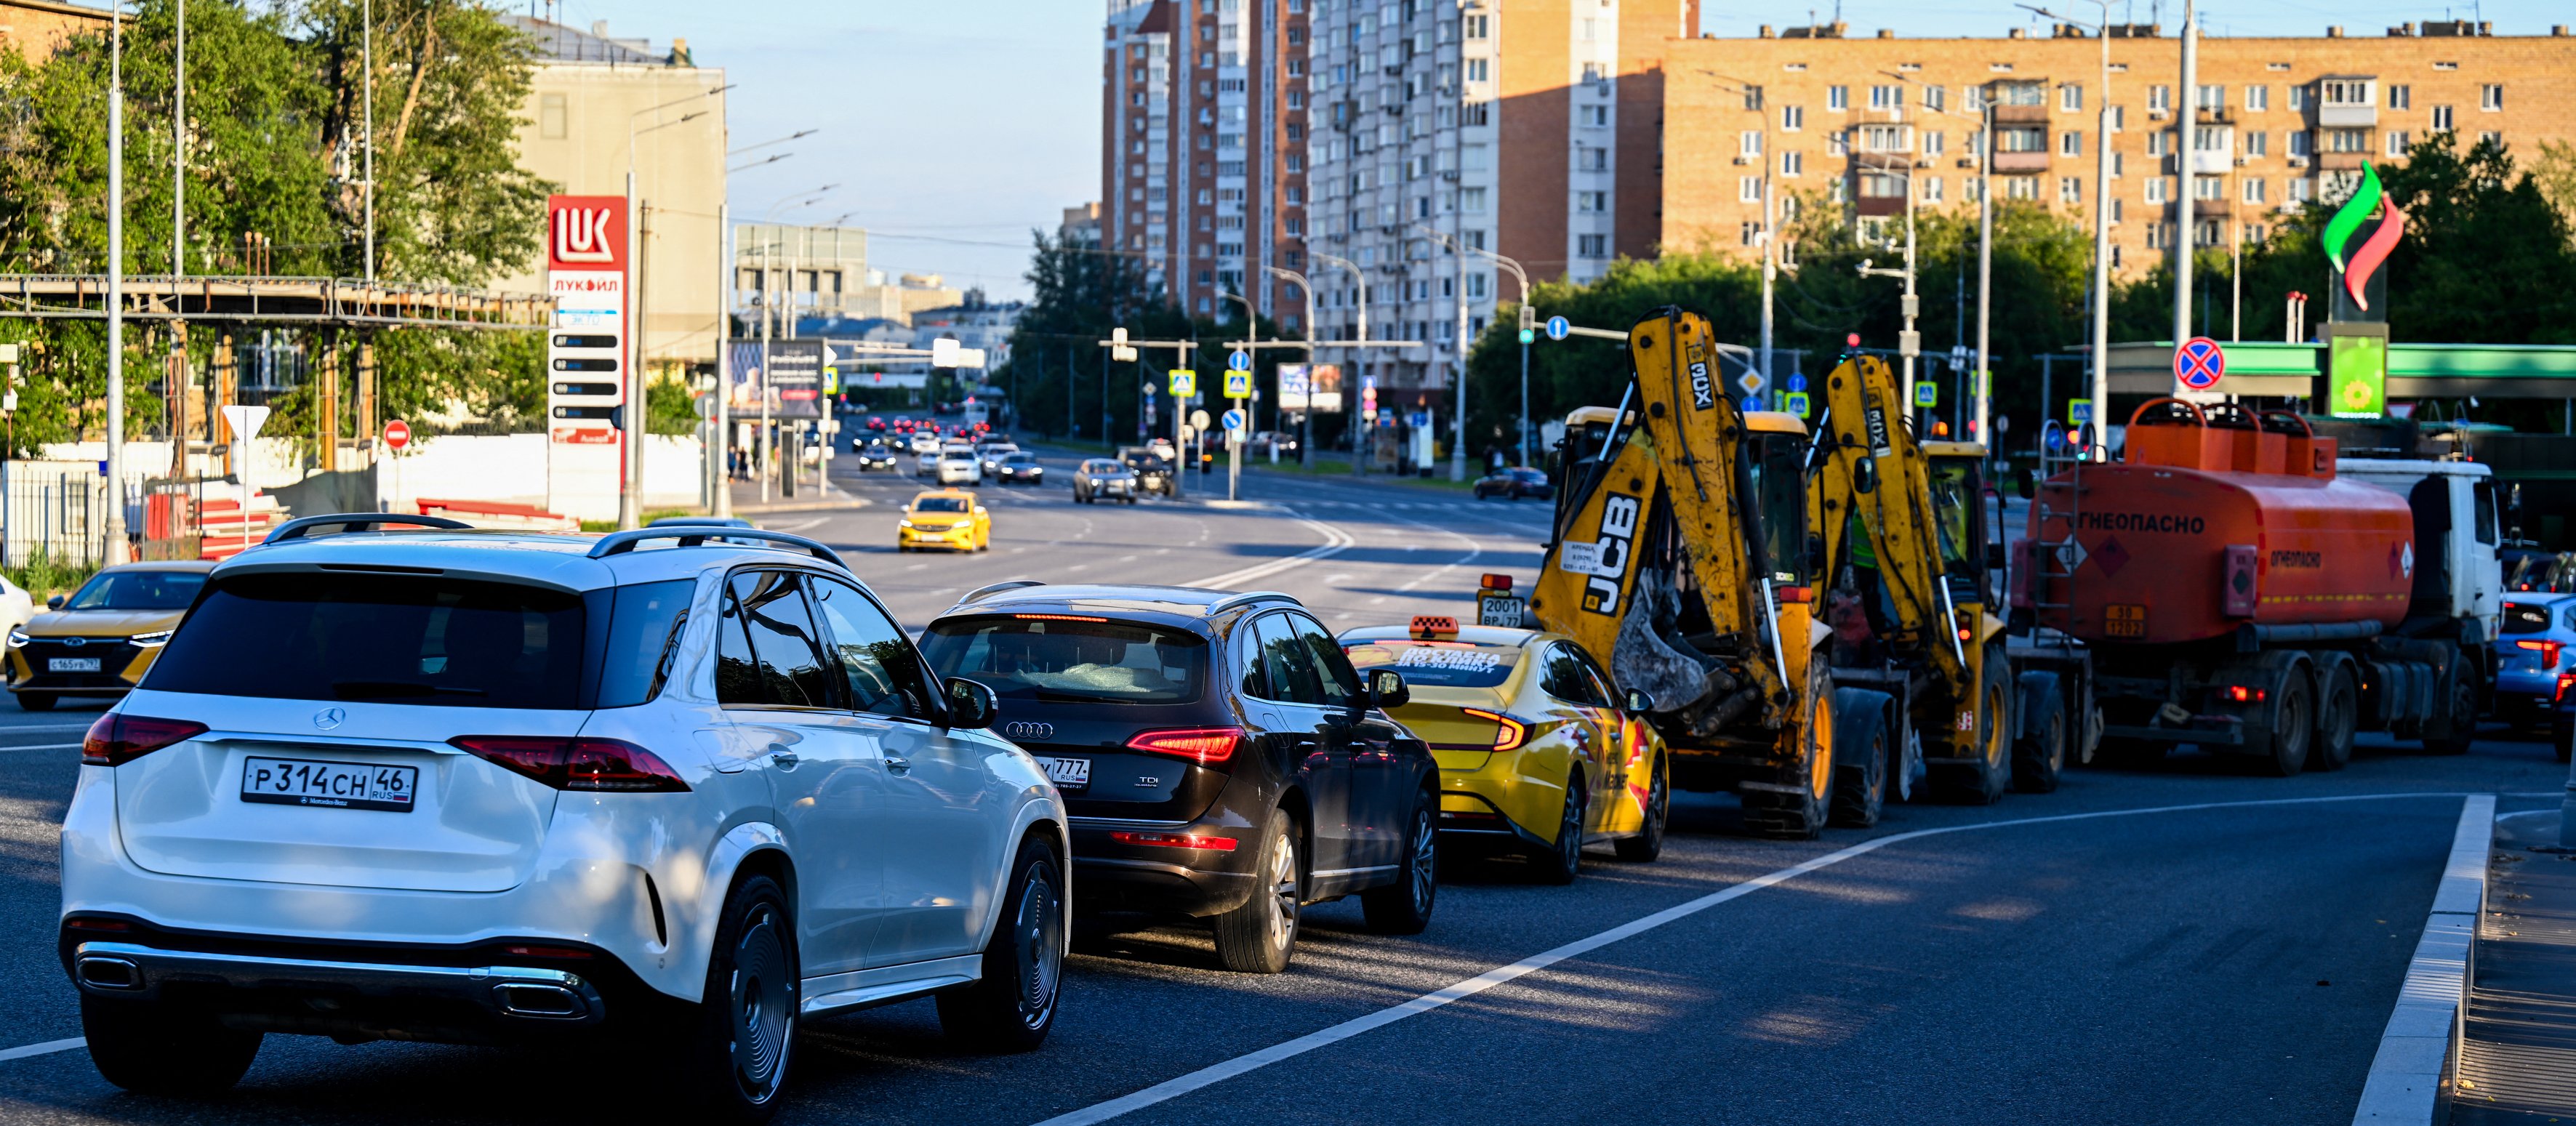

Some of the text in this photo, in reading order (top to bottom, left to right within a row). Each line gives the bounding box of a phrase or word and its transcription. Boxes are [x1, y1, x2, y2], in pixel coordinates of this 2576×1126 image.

[1690, 362, 1712, 405] 3CX
[1869, 409, 1886, 445] 3CX
[1589, 496, 1637, 613] JCB
[2271, 550, 2321, 568] ОГНЕОПАСНО
[1486, 600, 1517, 613] 2001
[2118, 607, 2132, 618] 30
[1506, 616, 1519, 627] 77
[2111, 622, 2140, 634] 1202
[1398, 654, 1500, 668] ПО КЛИКУ
[1448, 664, 1496, 674] МИНУТ
[1056, 759, 1084, 775] 777
[376, 769, 404, 792] 46
[309, 797, 348, 807] Mercedes-Benz
[372, 791, 393, 800] RUS
